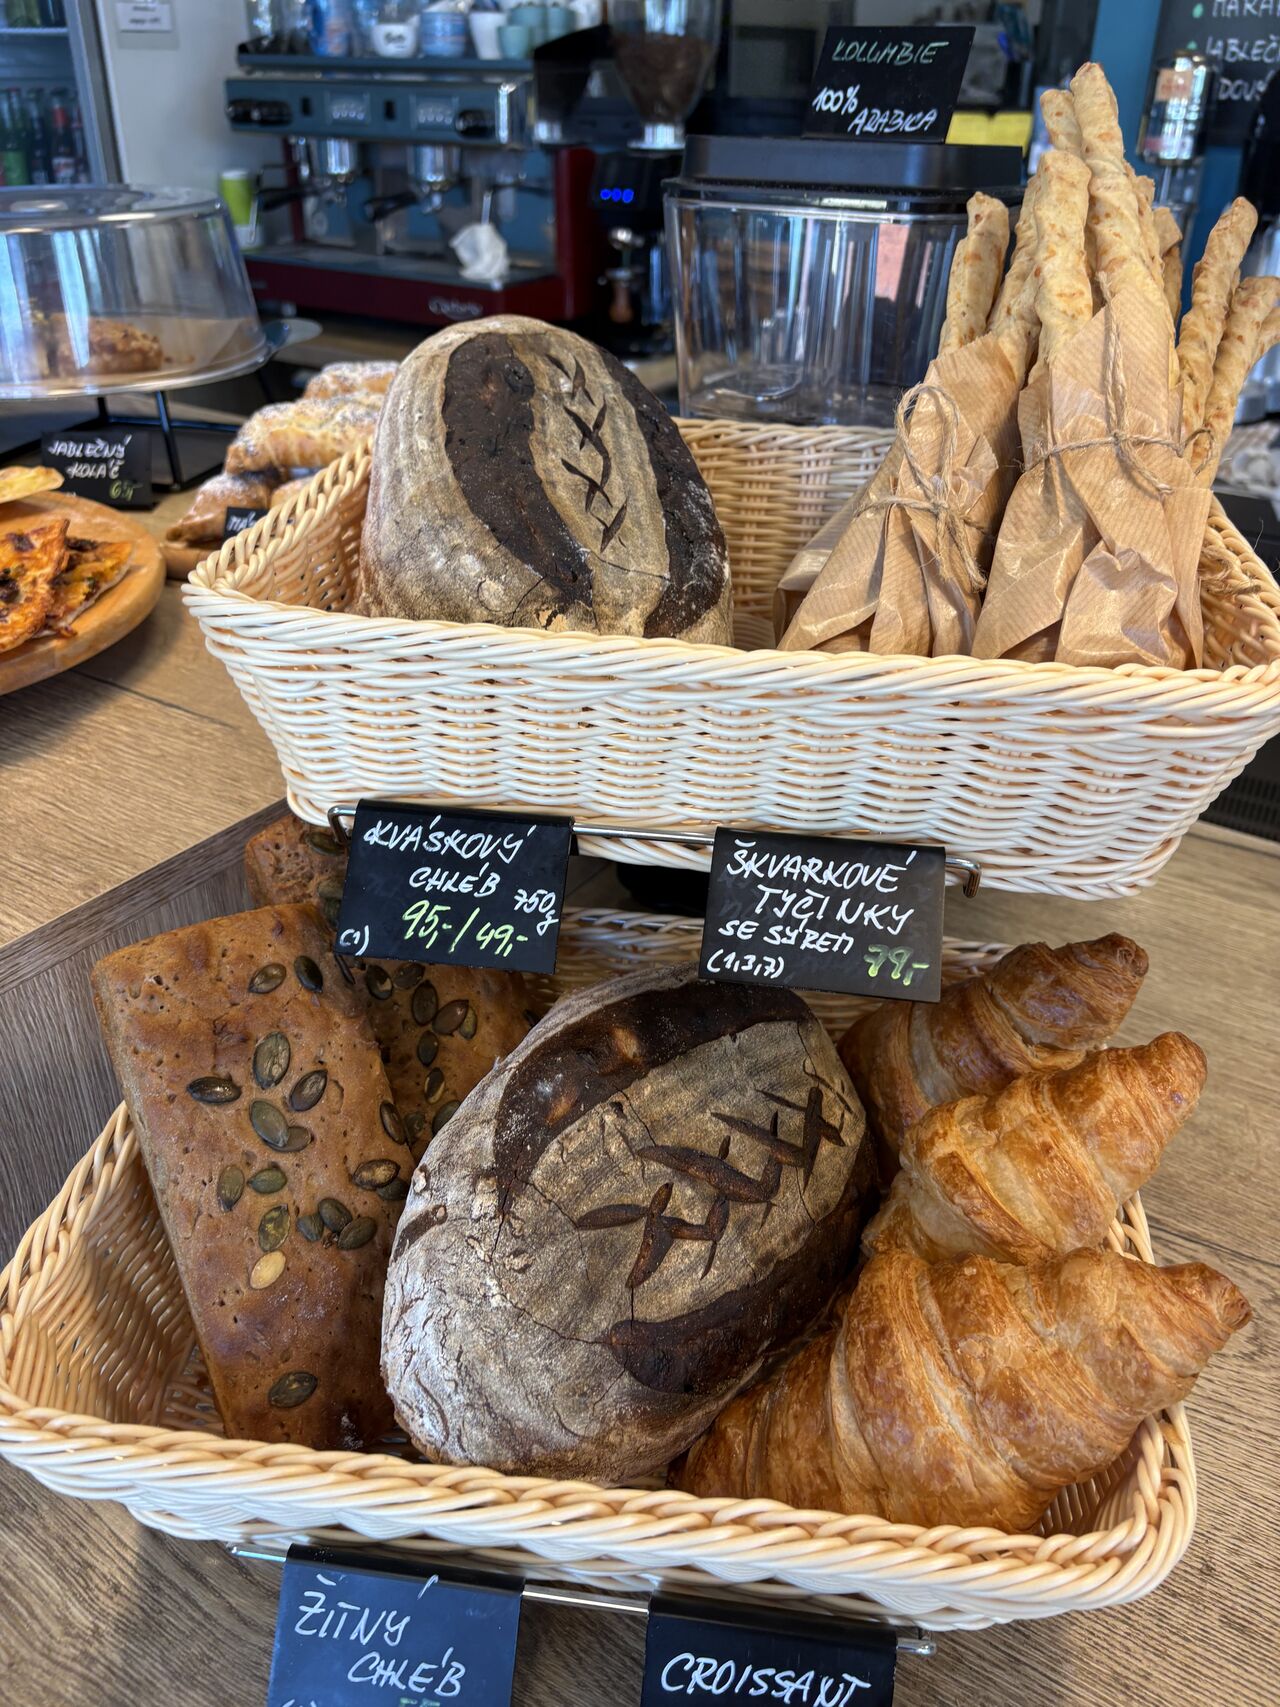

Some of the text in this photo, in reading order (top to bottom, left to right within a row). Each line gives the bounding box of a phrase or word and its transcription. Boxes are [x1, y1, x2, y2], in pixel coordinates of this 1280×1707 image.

[812, 84, 860, 115] 100%
[363, 815, 537, 864] KVÁSKOVÝ
[409, 862, 501, 898] CHLÉB
[727, 839, 917, 893] ŠKVARKOVÉ
[718, 920, 759, 940] SE
[755, 884, 914, 935] TYČINKY
[707, 949, 785, 979] (1,3,7)
[347, 1647, 466, 1697] CHLÉB
[661, 1652, 872, 1707] CROISSANT
